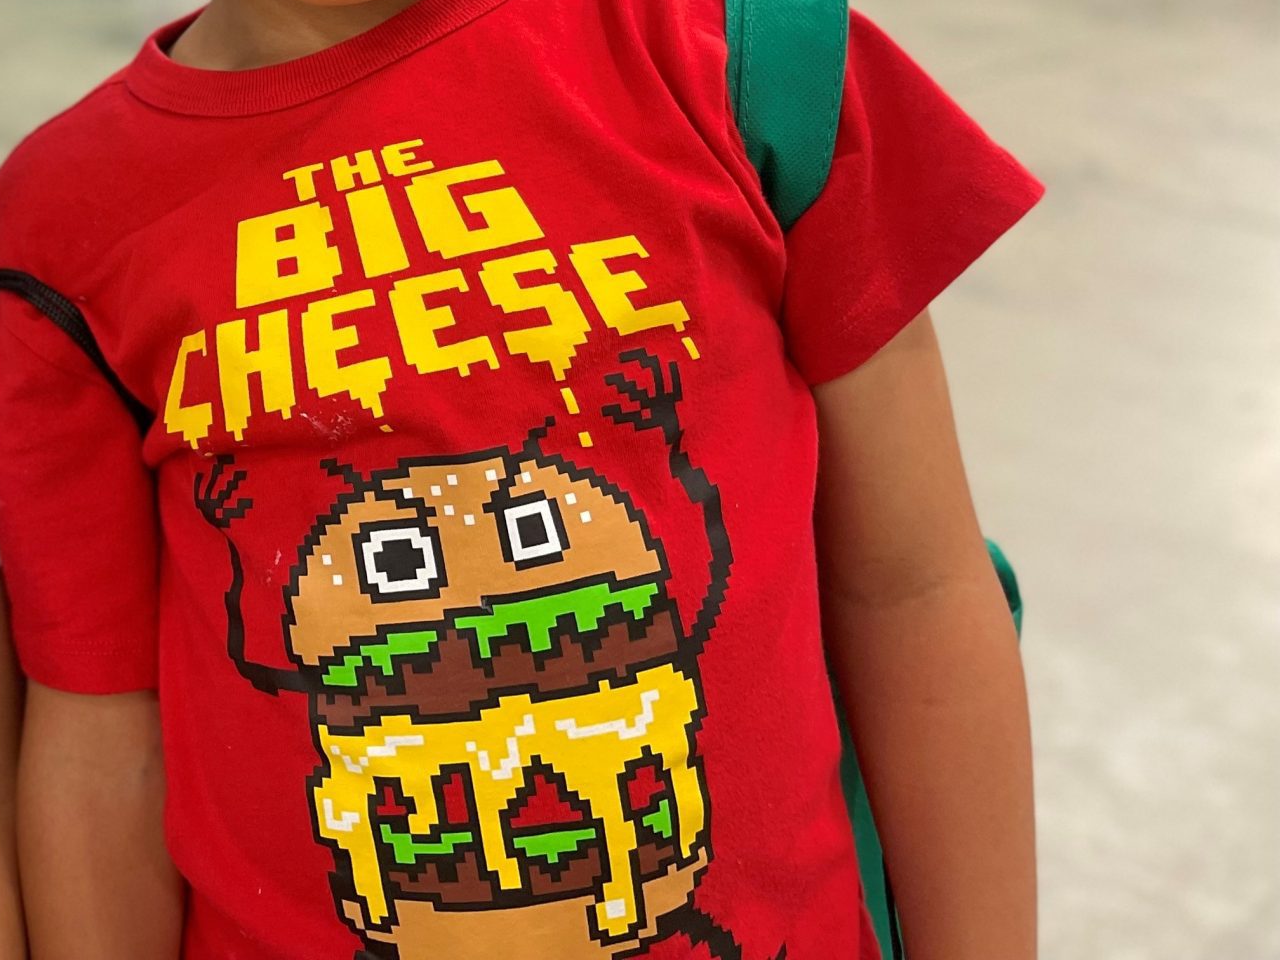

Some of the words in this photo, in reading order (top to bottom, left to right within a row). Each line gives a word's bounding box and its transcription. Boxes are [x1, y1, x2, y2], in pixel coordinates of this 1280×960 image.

[235, 159, 545, 309] BIG
[283, 139, 435, 202] THE
[163, 235, 696, 449] CHEESE
